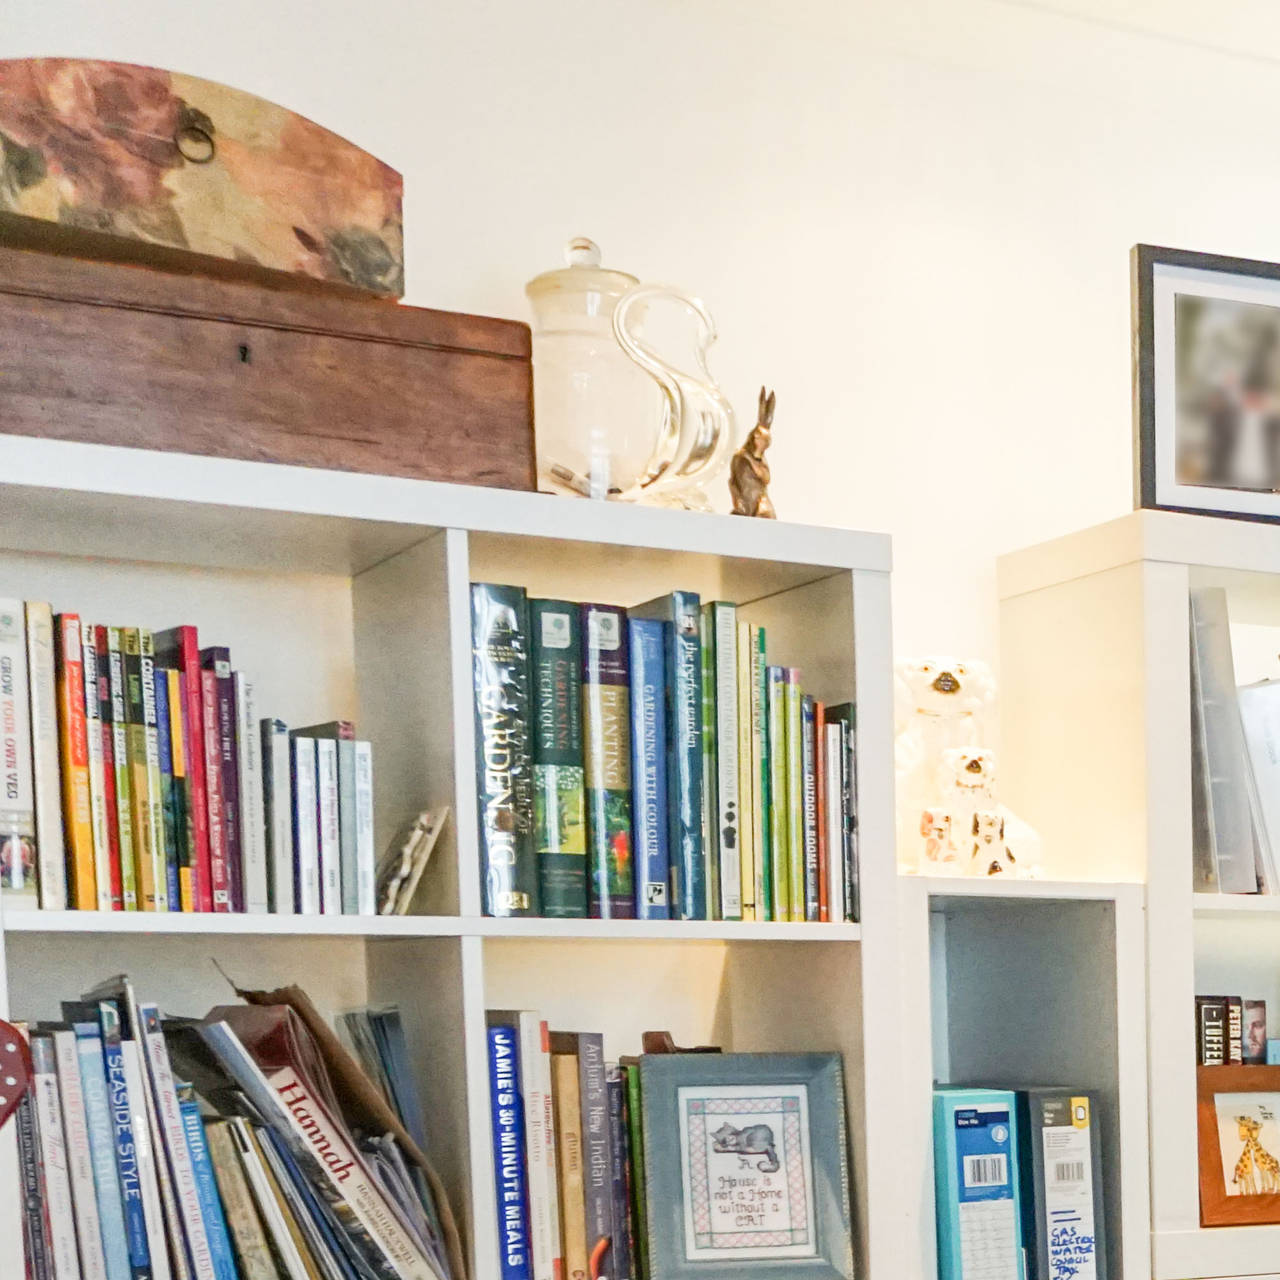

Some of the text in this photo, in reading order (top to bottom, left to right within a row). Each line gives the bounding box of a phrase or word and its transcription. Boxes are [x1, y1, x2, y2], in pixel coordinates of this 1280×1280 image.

[686, 642, 698, 662] the
[3, 655, 19, 799] GROW YOUR OWN VEG
[540, 663, 554, 748] TECHNIQUES
[554, 660, 570, 749] GARDENING
[686, 706, 700, 748] garden
[602, 690, 619, 784] PLANTING
[643, 685, 659, 856] GARDENING WITH COLOUR
[805, 774, 818, 869] OUTDOOR ROOMS
[1229, 1005, 1242, 1038] PETER
[108, 1055, 132, 1135] SEASIDE
[495, 1034, 514, 1105] JAMIE'S
[184, 1115, 203, 1162] BIRDS
[277, 1080, 355, 1183] Hannah
[585, 1043, 607, 1187] Anjum's New Indian
[119, 1143, 140, 1200] STYLE
[499, 1109, 519, 1202] 30-MINUTE
[718, 1175, 771, 1189] House is
[737, 1156, 753, 1170] A
[714, 1189, 783, 1201] not a Home
[718, 1202, 779, 1214] without a
[735, 1214, 766, 1227] CAT
[505, 1206, 524, 1266] MEALS
[1051, 1227, 1077, 1238] GAS
